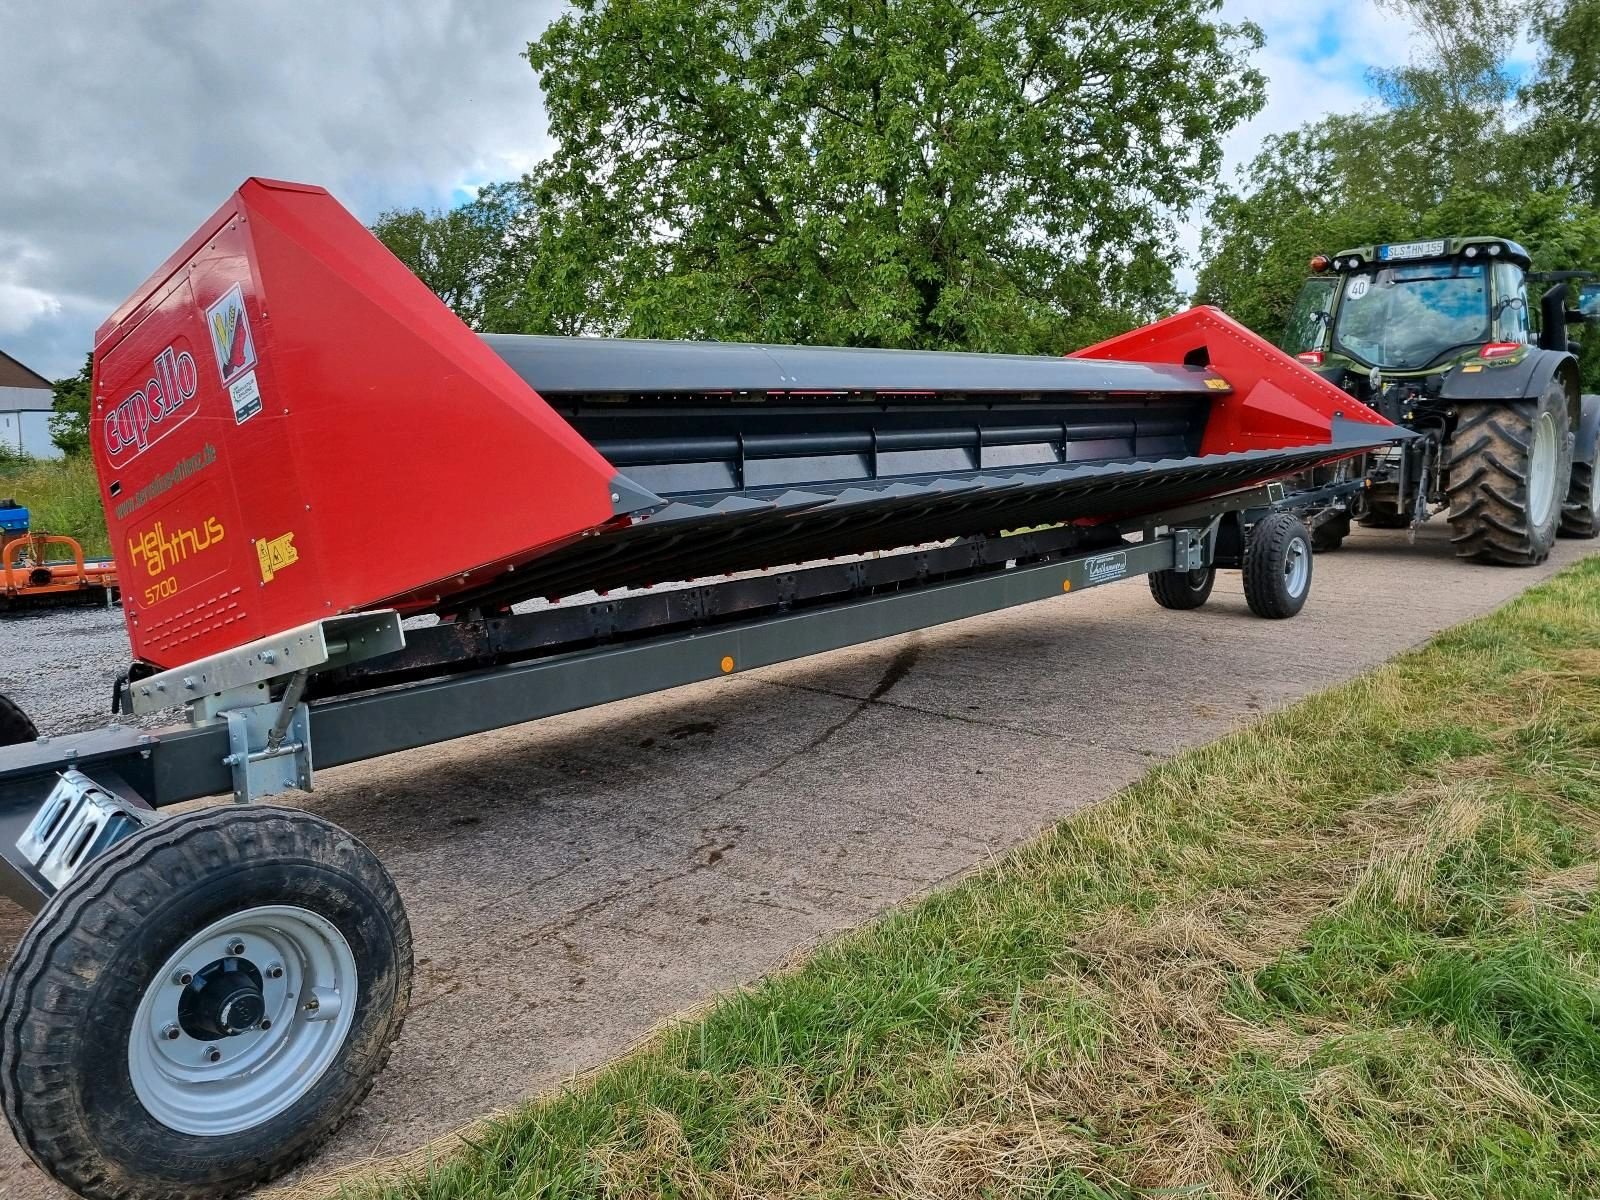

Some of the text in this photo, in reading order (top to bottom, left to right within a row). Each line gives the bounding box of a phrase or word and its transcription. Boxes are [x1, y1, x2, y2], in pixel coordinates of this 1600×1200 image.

[1425, 242, 1443, 253] 155
[1351, 280, 1365, 296] 40
[104, 346, 197, 454] capello
[145, 577, 177, 604] 5700
